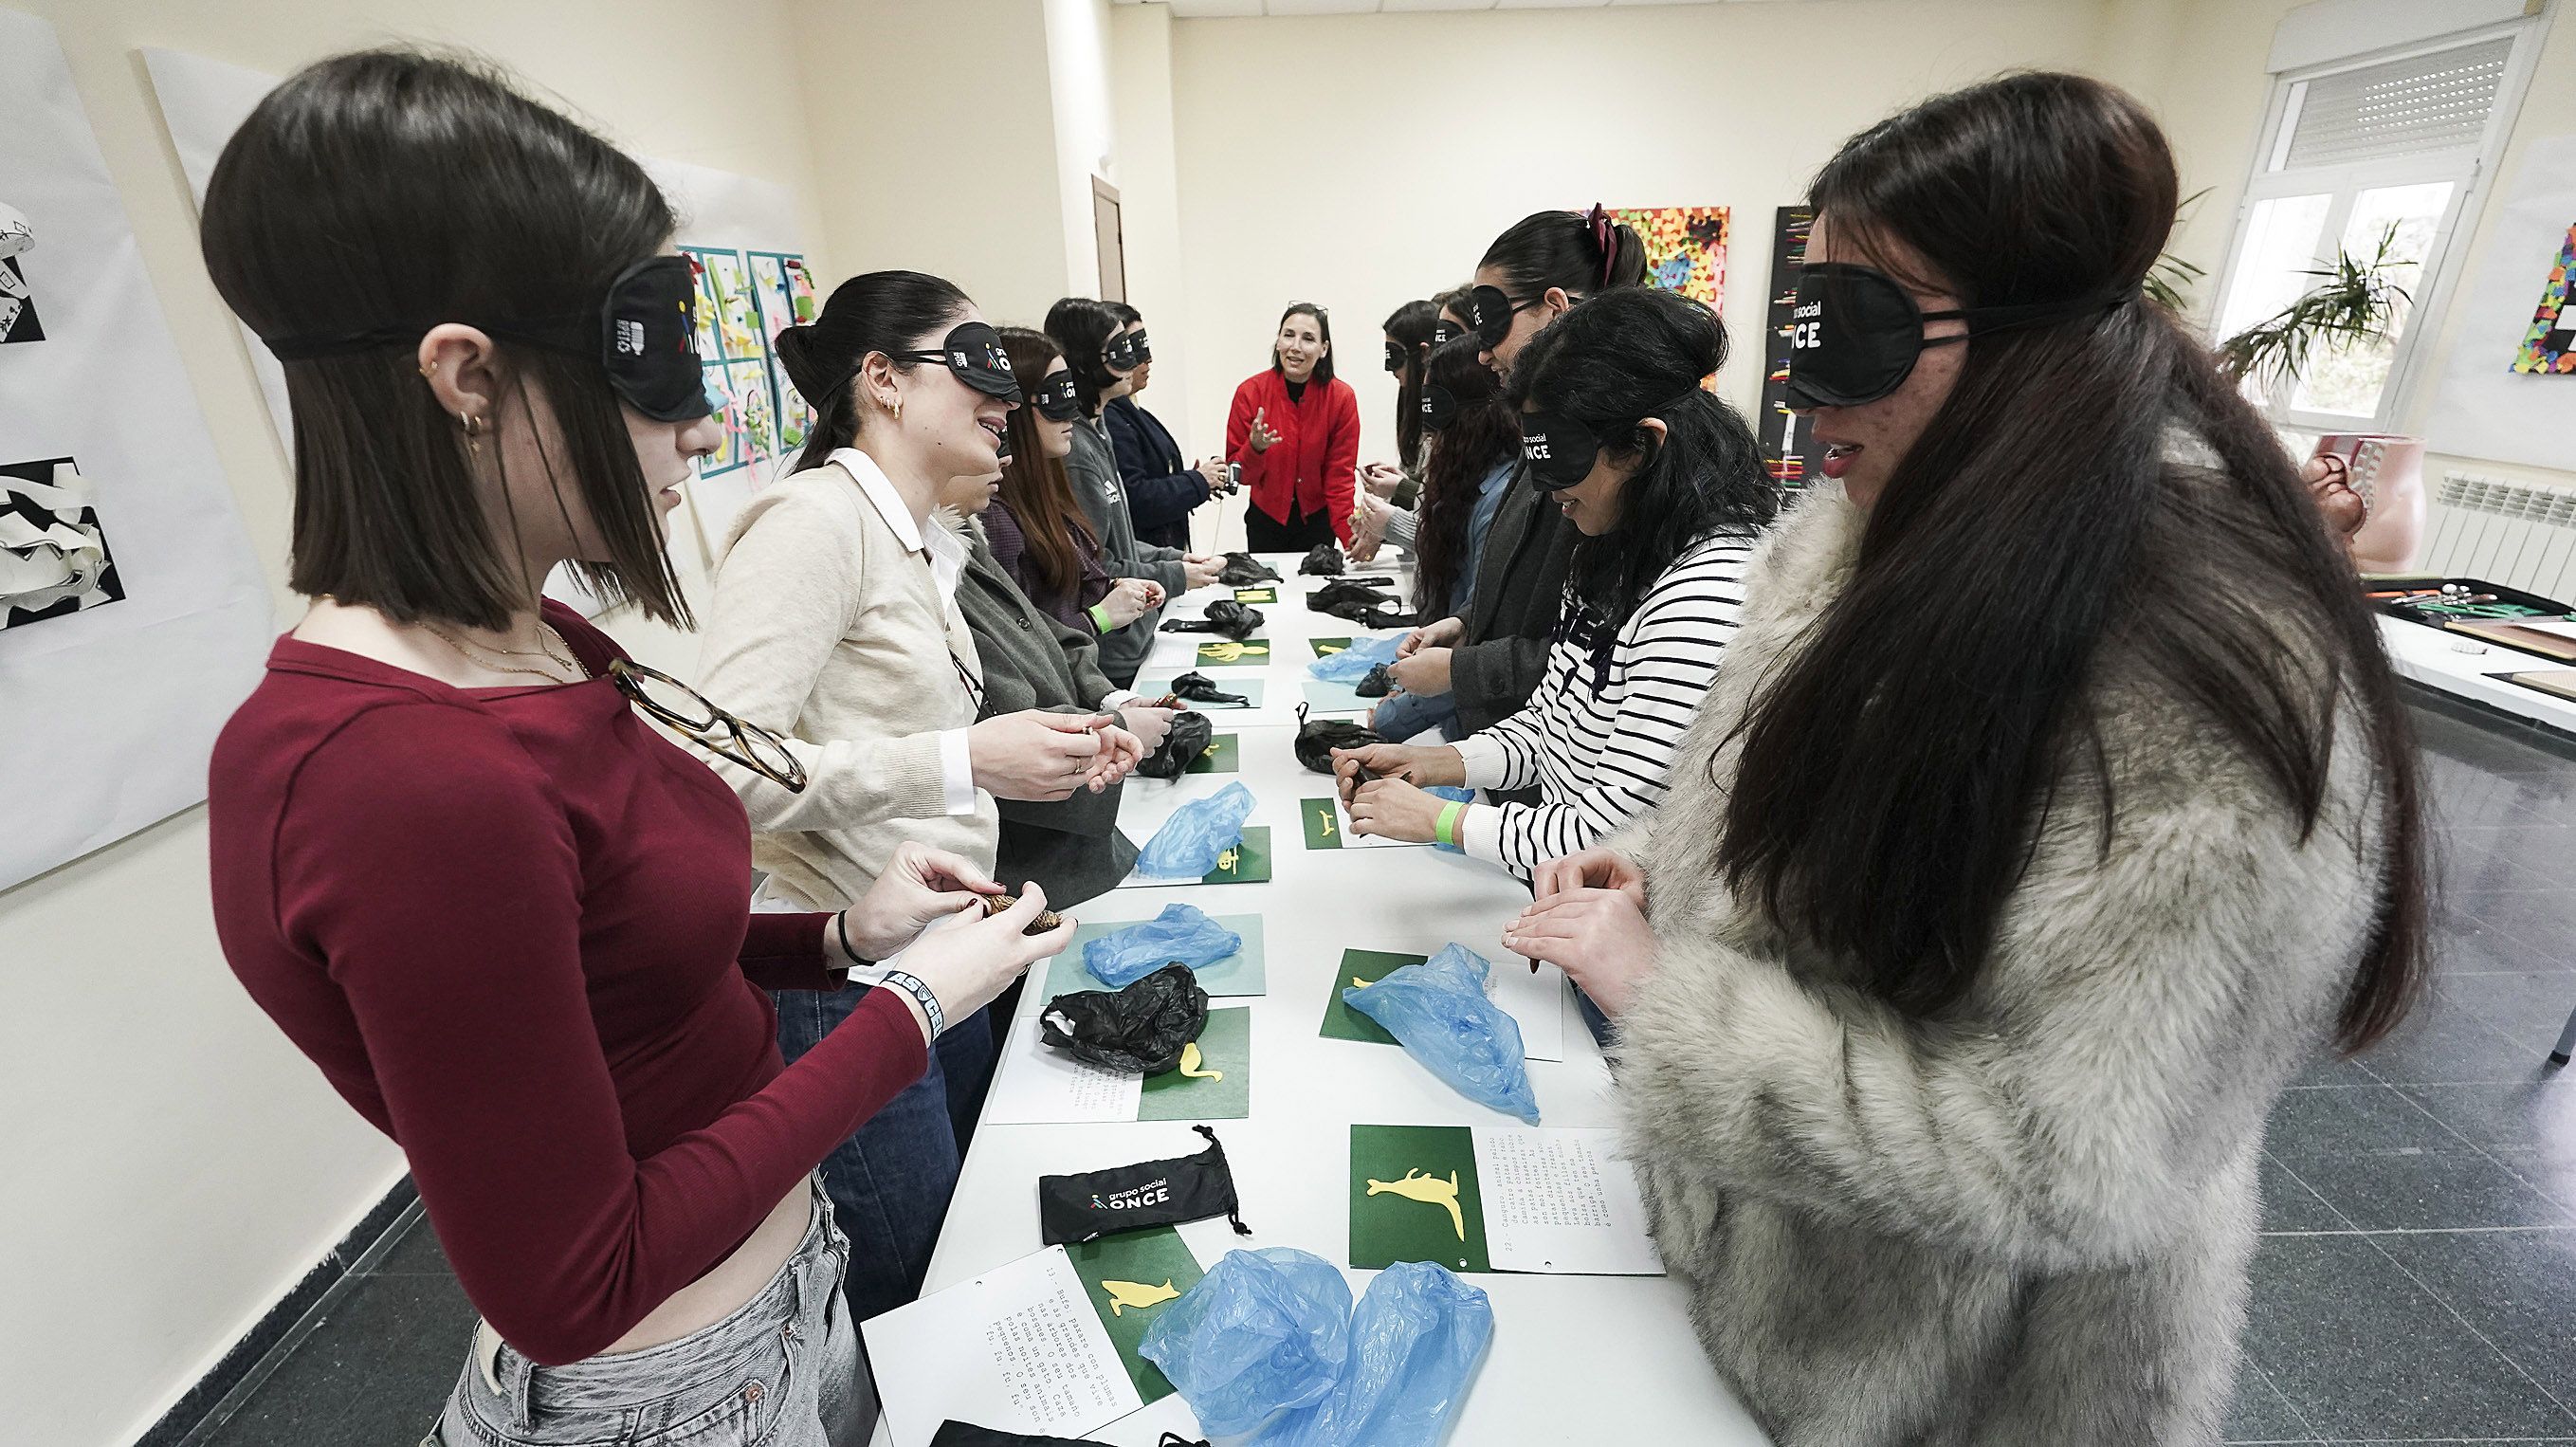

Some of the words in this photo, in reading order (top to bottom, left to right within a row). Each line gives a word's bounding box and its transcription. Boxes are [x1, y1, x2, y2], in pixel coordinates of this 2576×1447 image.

[1791, 322, 1821, 349] CE
[1503, 1163, 1513, 1184] patas
[1560, 1162, 1571, 1186] fillos
[1108, 1187, 1139, 1201] grupo
[1139, 1177, 1167, 1192] social
[1109, 1187, 1170, 1210] ONCE
[1507, 1187, 1516, 1210] catro
[1526, 1189, 1538, 1211] patas
[1510, 1215, 1519, 1224] de
[1549, 1202, 1562, 1225] patas
[1571, 1207, 1580, 1226] Leva
[1580, 1203, 1591, 1226] bolsa
[1588, 1192, 1601, 1227] barriga.
[1027, 1306, 1047, 1346] bosques.
[1051, 1362, 1063, 1379] seu
[1037, 1302, 1049, 1318] nas
[1065, 1362, 1077, 1380] dos
[993, 1320, 1016, 1366] pequenos.
[1020, 1383, 1032, 1401] seu
[1029, 1404, 1041, 1422] son
[1003, 1315, 1021, 1342] polas
[1017, 1346, 1036, 1379] noites
[1033, 1383, 1054, 1422] animais
[1020, 1321, 1033, 1343] coma
[1032, 1346, 1040, 1358] un
[1036, 1361, 1052, 1388] gato.
[1052, 1393, 1067, 1418] Caza
[1058, 1322, 1081, 1358] grandes
[1077, 1363, 1090, 1380] que
[1089, 1383, 1104, 1406] vive
[1068, 1317, 1088, 1348] paxaro
[1087, 1353, 1099, 1370] con
[1095, 1373, 1118, 1407] plumas
